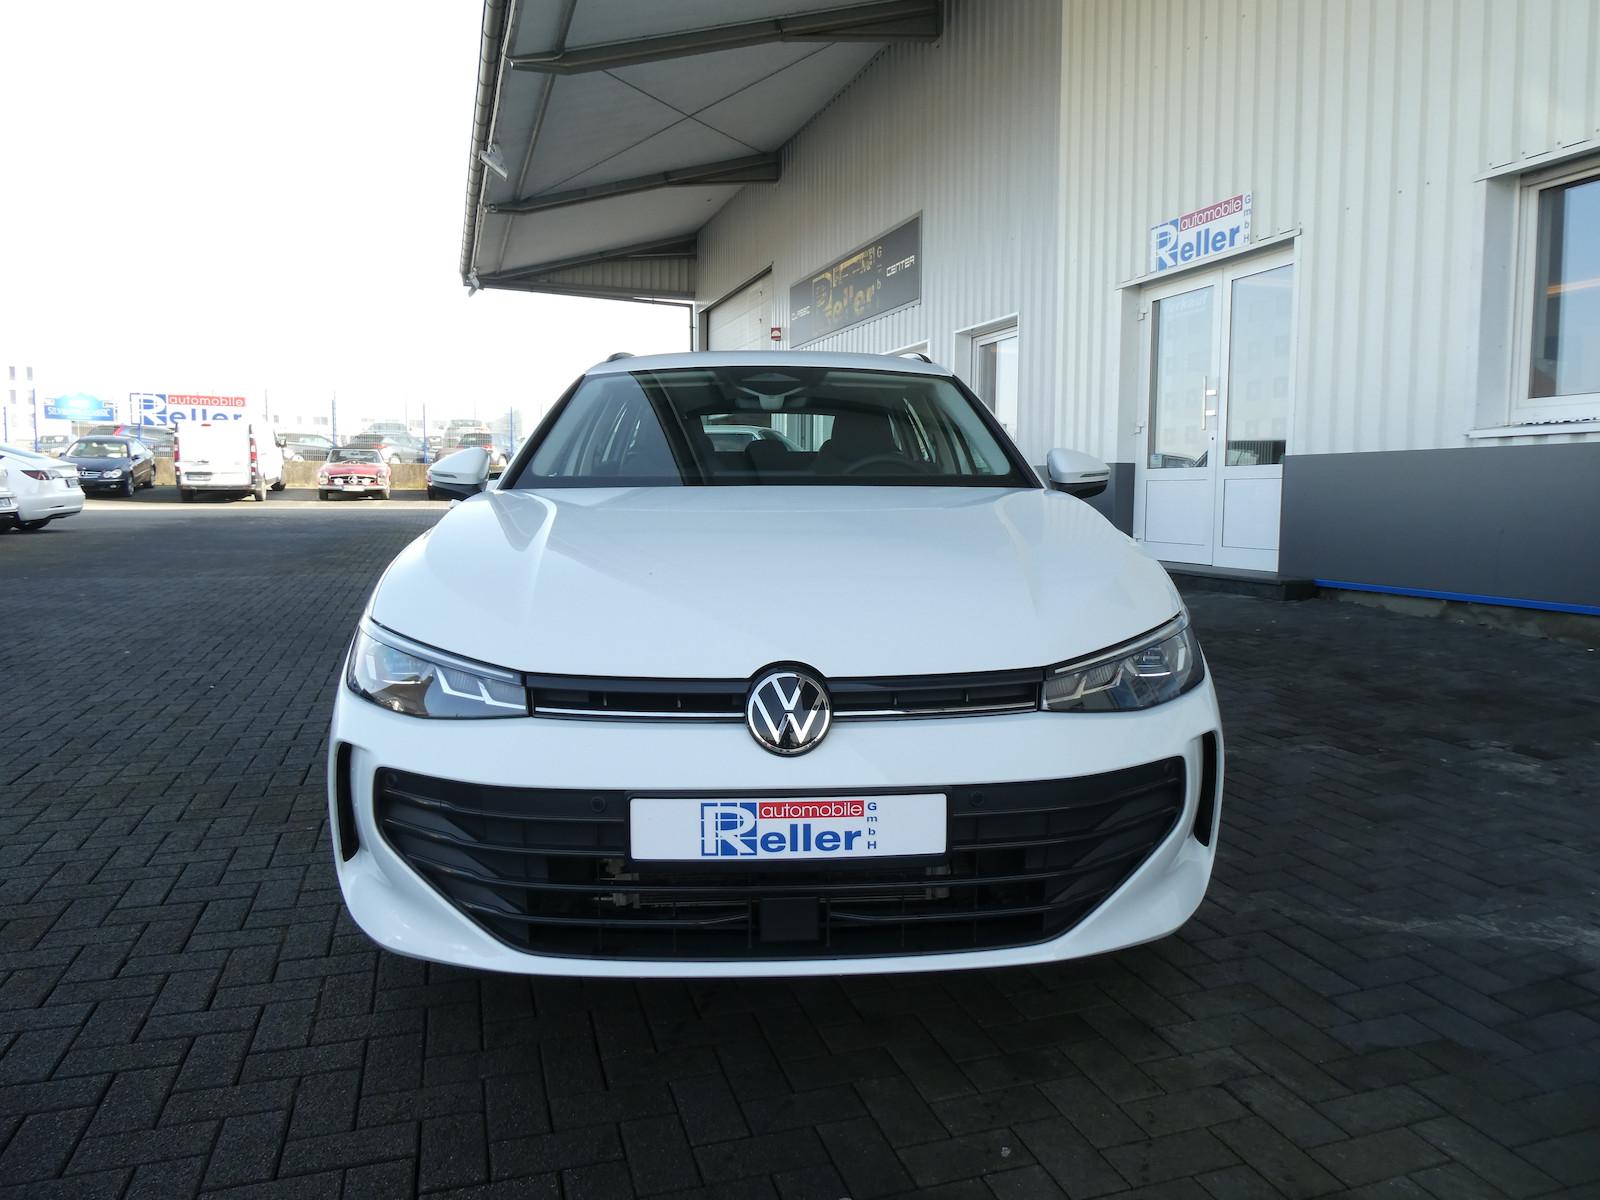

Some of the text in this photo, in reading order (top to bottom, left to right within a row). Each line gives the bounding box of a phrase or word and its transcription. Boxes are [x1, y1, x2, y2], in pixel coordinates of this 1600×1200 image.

[1180, 198, 1242, 231] automobile
[1150, 219, 1240, 273] Reller
[885, 254, 916, 278] CENTER
[168, 395, 245, 407] automobile
[760, 801, 863, 818] automobile
[866, 801, 878, 850] GmbH
[701, 803, 862, 856] Reller
